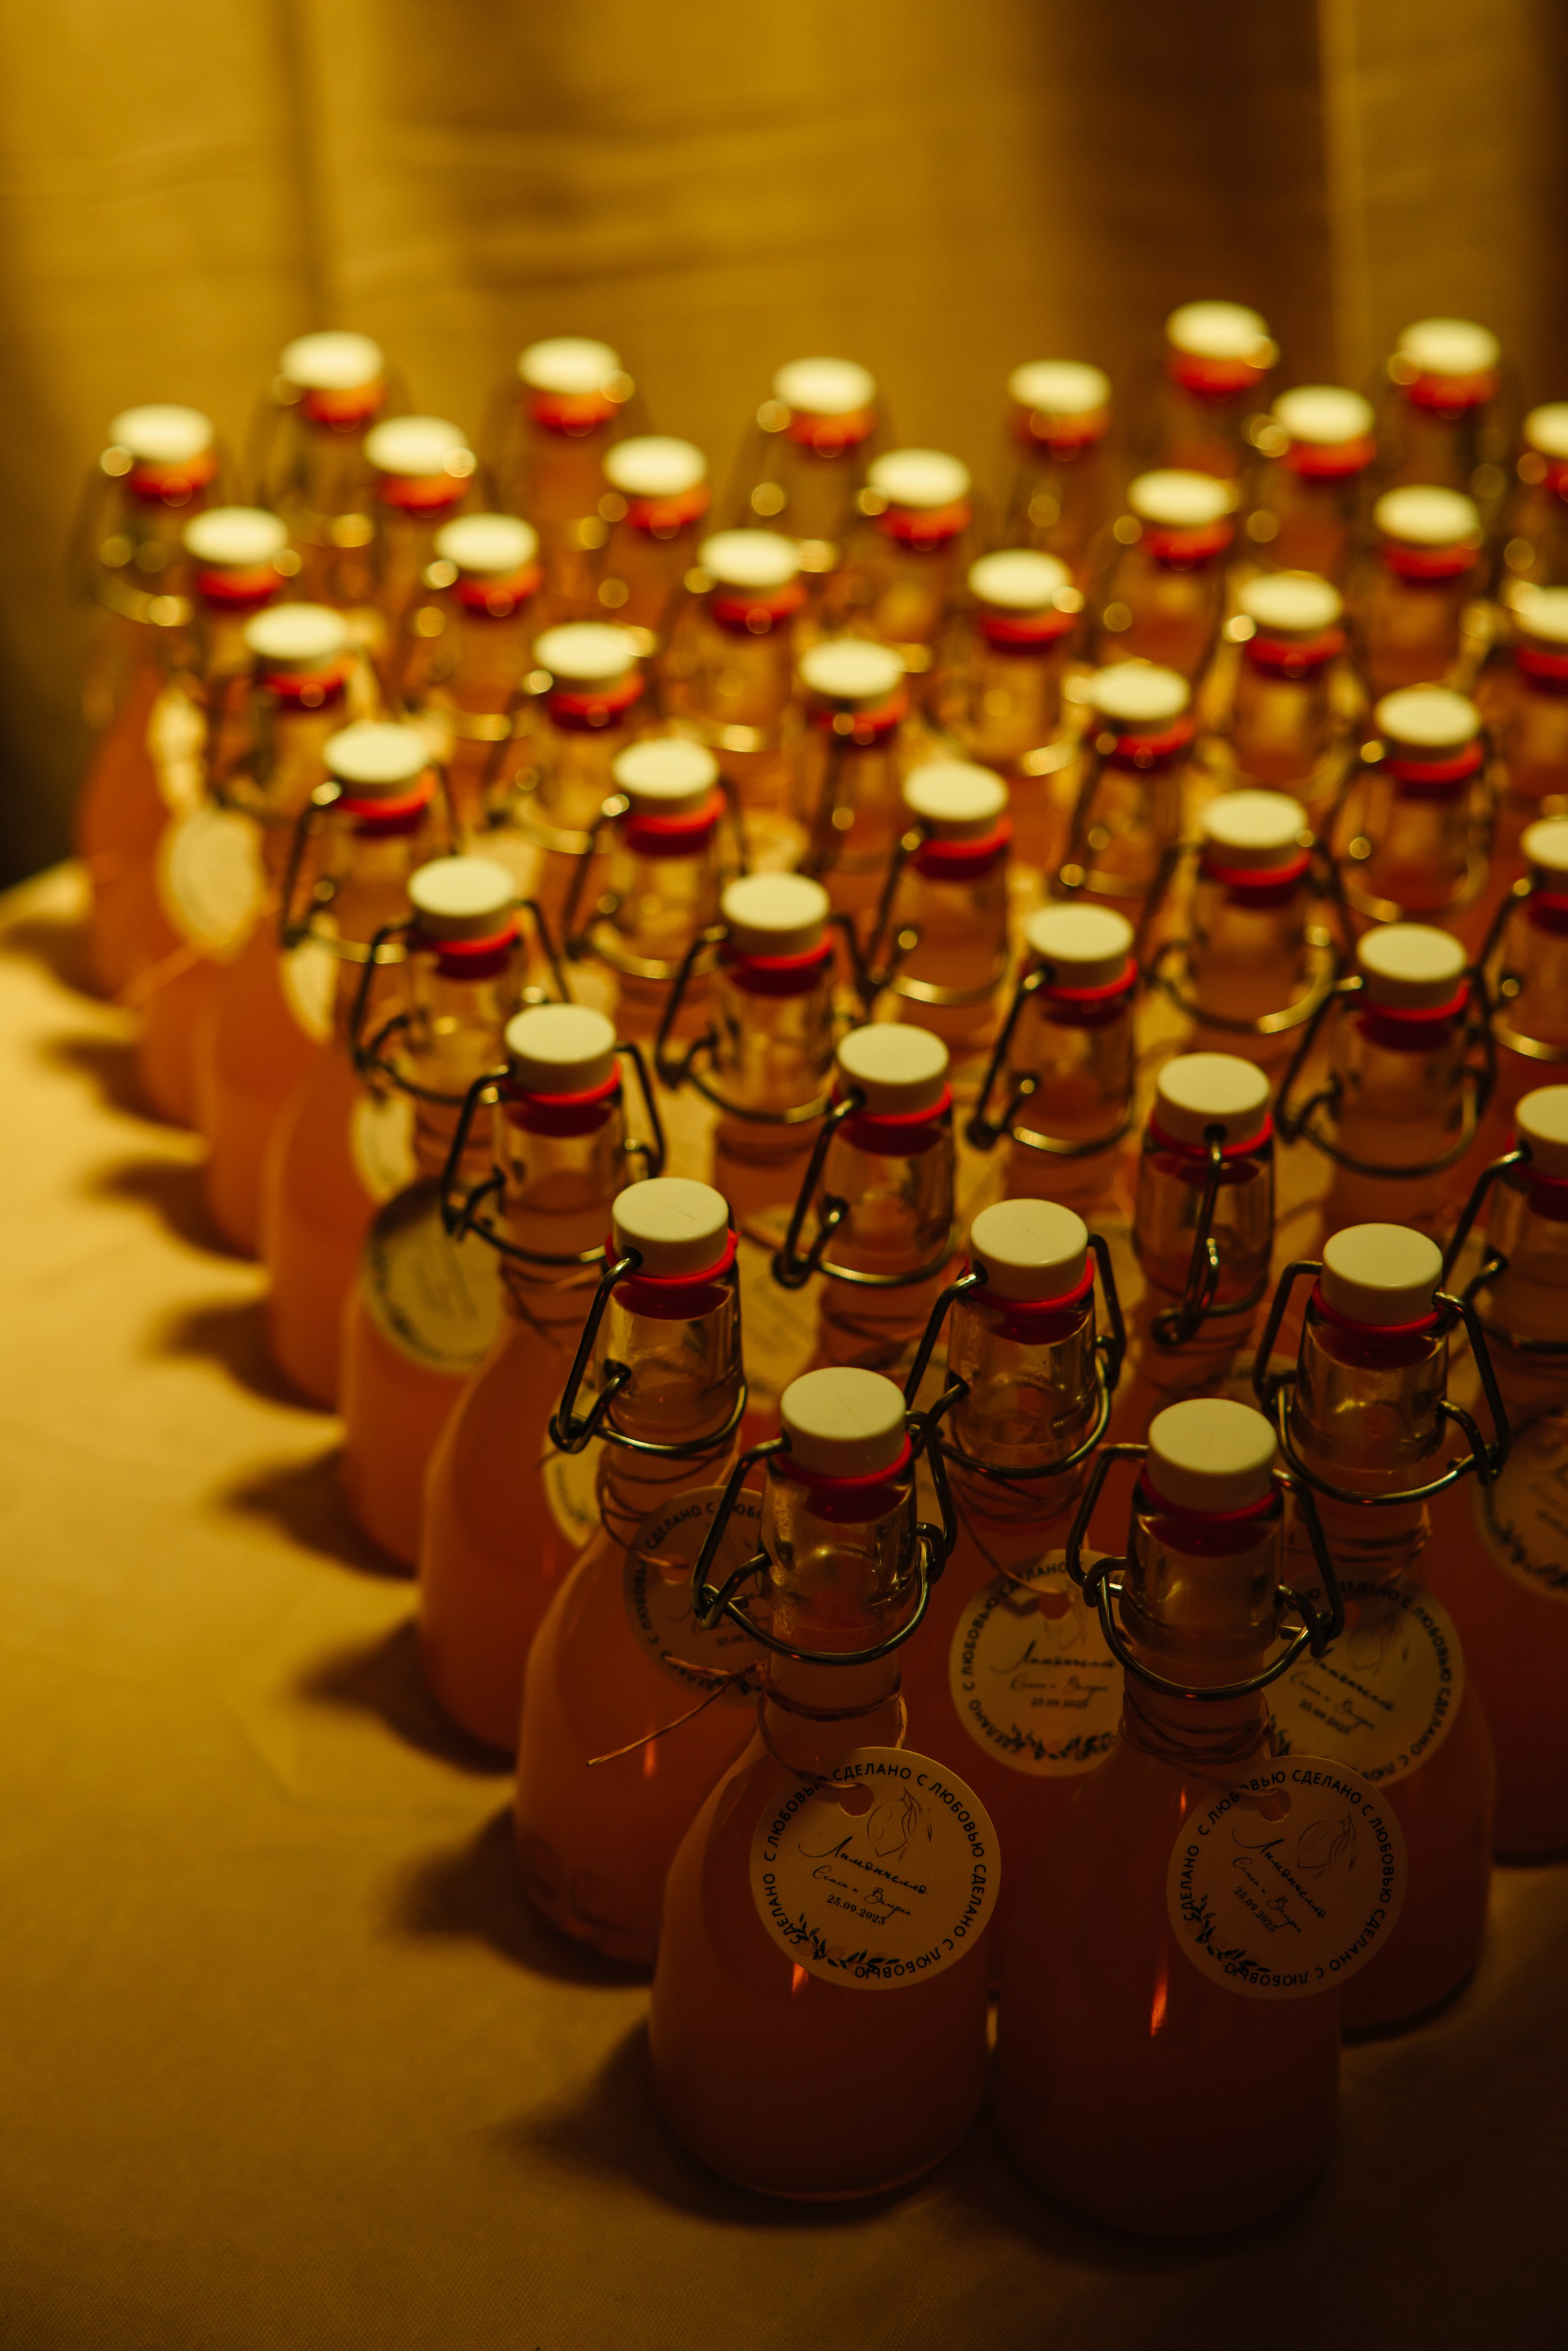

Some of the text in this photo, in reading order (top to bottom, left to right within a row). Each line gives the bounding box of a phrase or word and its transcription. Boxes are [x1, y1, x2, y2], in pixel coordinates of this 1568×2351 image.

[833, 1762, 912, 1781] СДЕЛАНО
[916, 1774, 928, 1787] С
[1292, 1770, 1362, 1805] СДЕЛАНО
[929, 1782, 984, 1856] ЛЮБОВЬЮ
[1362, 1805, 1373, 1817] С
[1199, 1824, 1209, 1836] С
[764, 1852, 776, 1862] С
[798, 1835, 930, 1895] Лимончелло
[1369, 1817, 1394, 1903] ЛЮБОВЬЮ
[1180, 1845, 1199, 1921] СДЕЛАНО
[1232, 1828, 1327, 1920] Лимончелло
[762, 1873, 805, 1945] СДЕЛАНО
[827, 1894, 888, 1925] 25.09.2025
[954, 1865, 986, 1938] СДЕЛАНО
[1234, 1886, 1277, 1933] 25.09.2025
[941, 1939, 954, 1951] С
[1329, 1909, 1385, 1972] СДЕЛАНО
[855, 1947, 941, 1979] ЛЮБОВЬЮ
[1224, 1961, 1308, 1987] ЛЮБОВЬЮ
[1315, 1967, 1324, 1979] С
